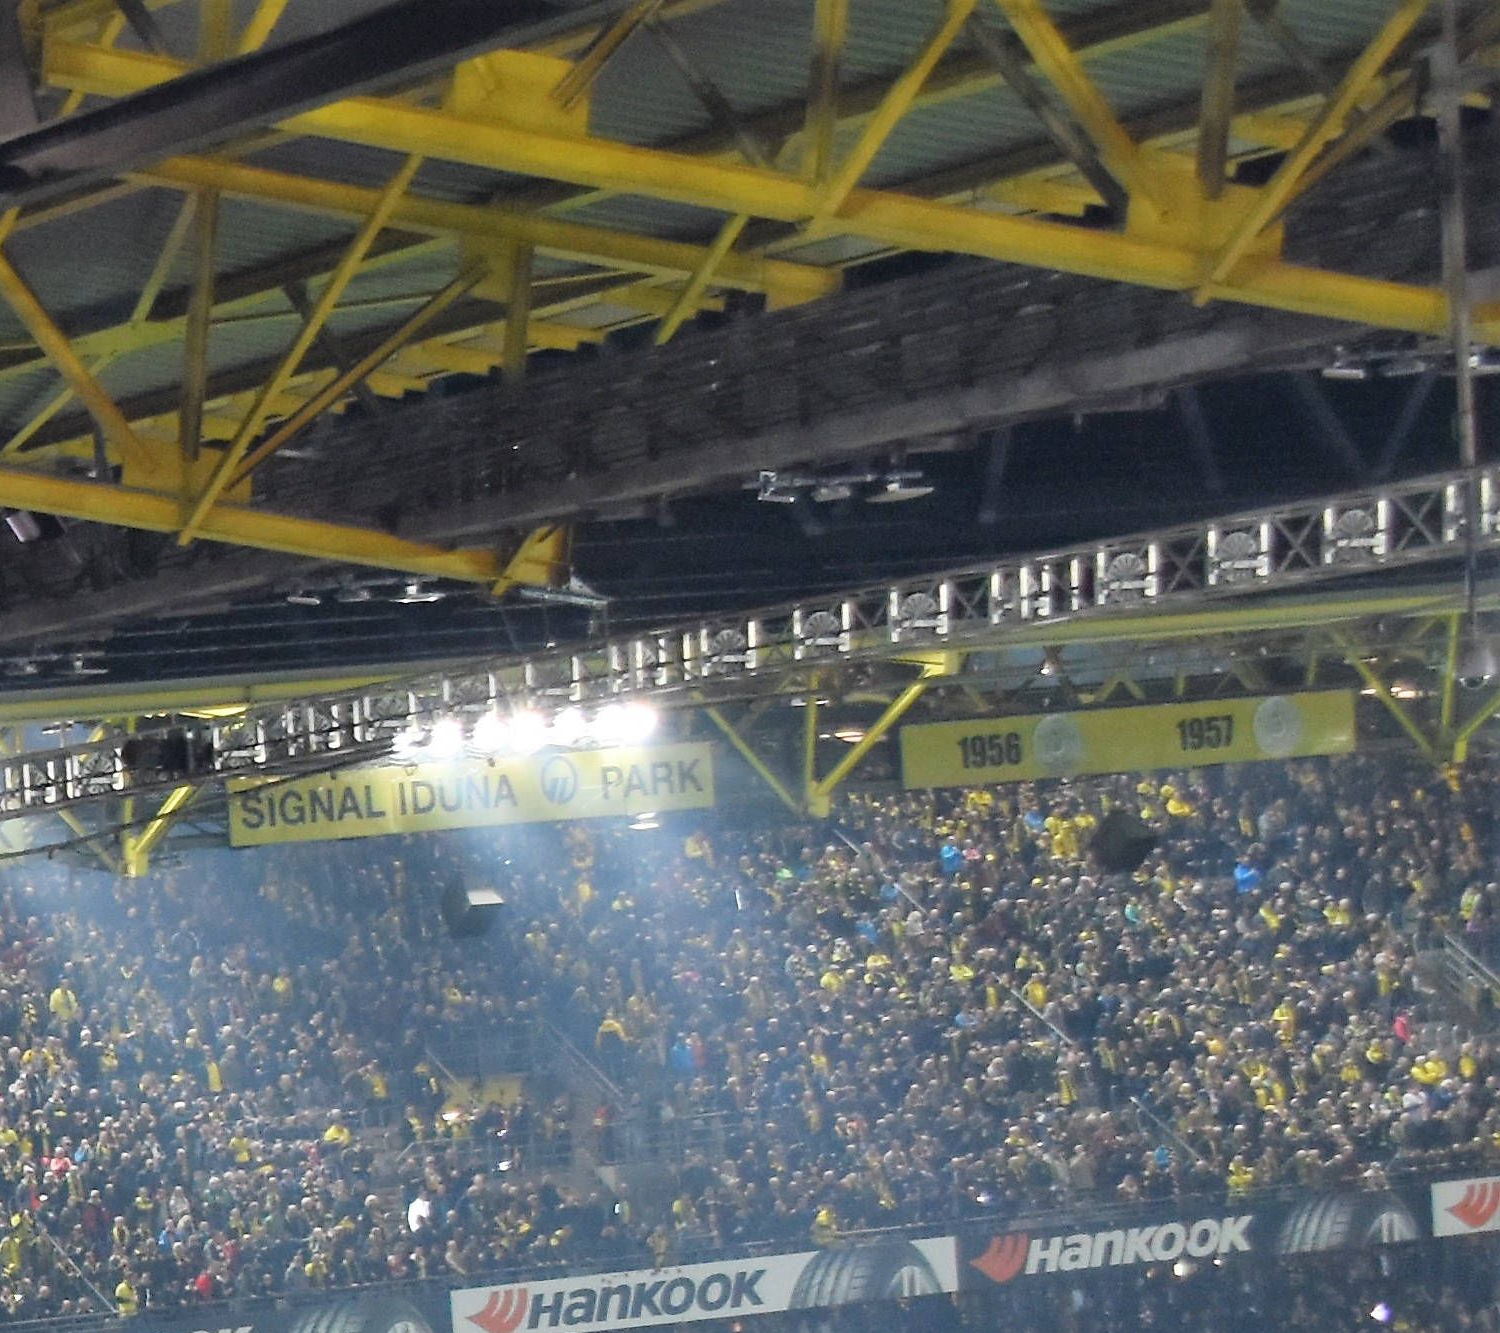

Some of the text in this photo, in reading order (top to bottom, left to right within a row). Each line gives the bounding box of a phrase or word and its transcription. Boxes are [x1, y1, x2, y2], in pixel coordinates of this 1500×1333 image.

[957, 732, 1022, 769] 1956
[1176, 714, 1234, 751] 1957
[241, 759, 704, 830] SIGNAL IDUNA PARK
